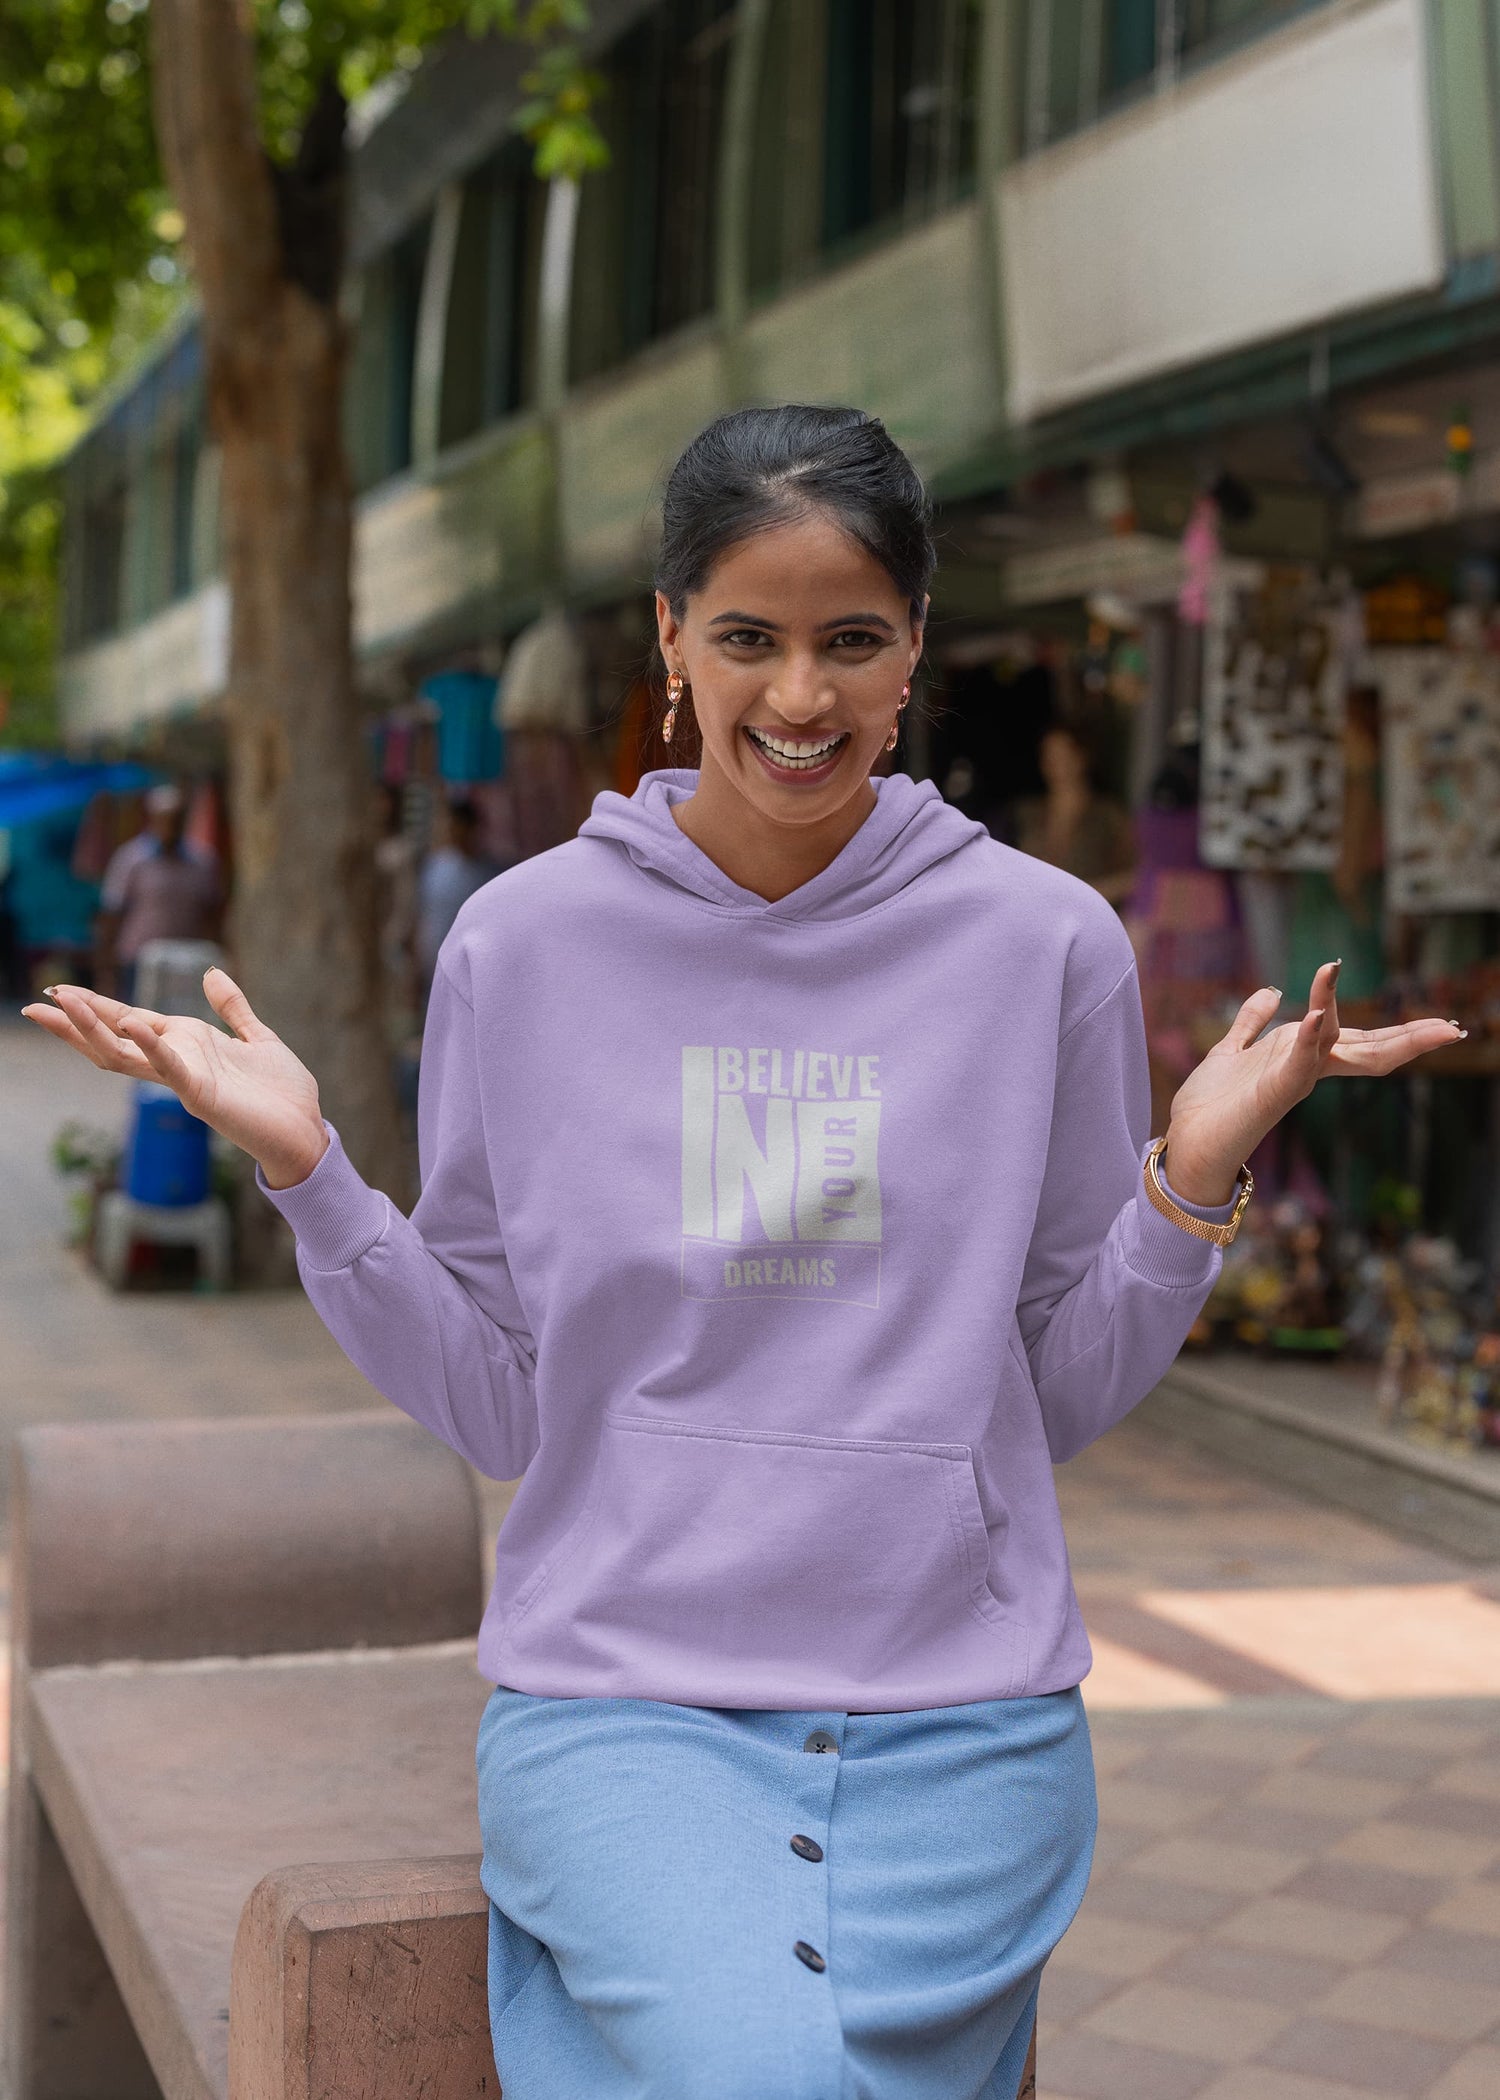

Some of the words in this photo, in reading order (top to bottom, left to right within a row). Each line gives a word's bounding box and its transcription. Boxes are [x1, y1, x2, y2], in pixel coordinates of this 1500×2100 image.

[718, 1047, 882, 1099] BELIEVE
[681, 1045, 795, 1242] IN
[822, 1116, 857, 1224] YOUR
[724, 1257, 837, 1288] DREAMS
